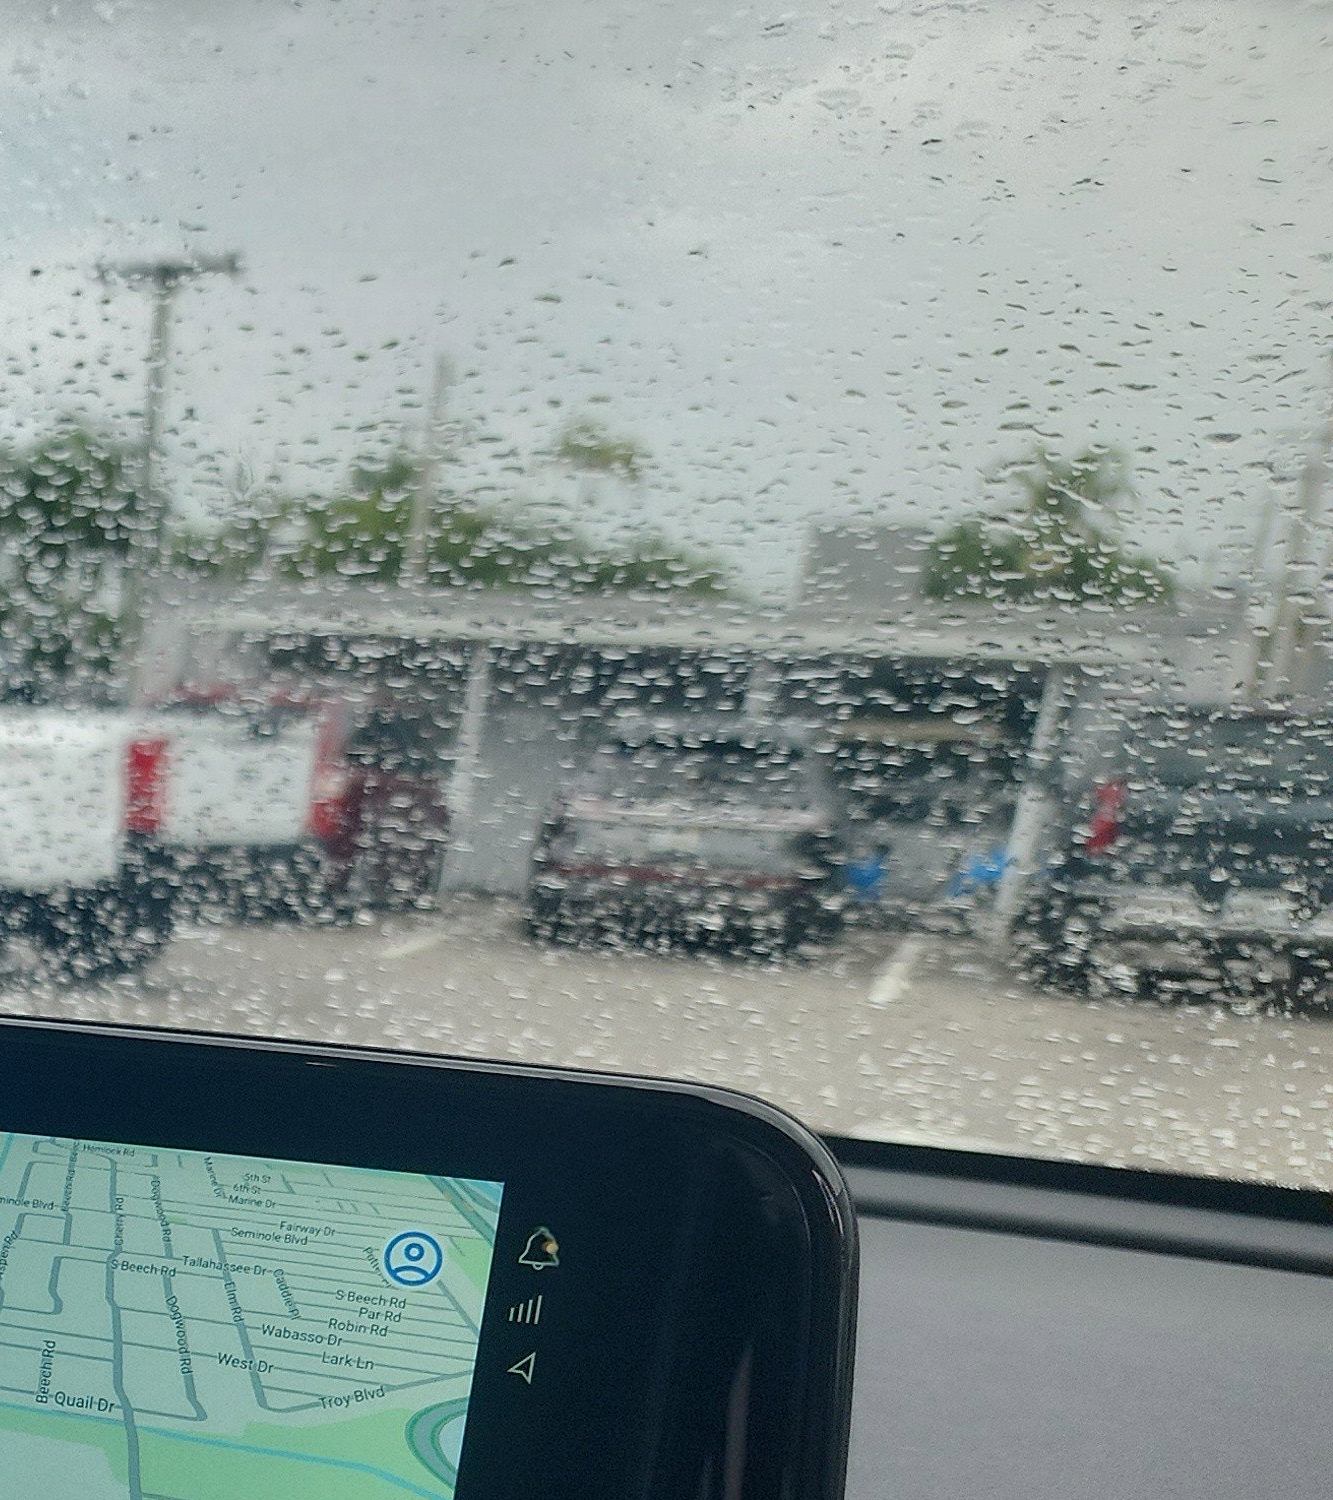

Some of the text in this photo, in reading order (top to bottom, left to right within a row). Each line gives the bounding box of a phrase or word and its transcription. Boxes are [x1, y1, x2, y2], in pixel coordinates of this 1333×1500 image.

[203, 1156, 223, 1188] Marine
[33, 1199, 55, 1210] Blvd
[229, 1193, 276, 1208] Marine Dr
[114, 1197, 125, 1246] Cherry Rd
[279, 1221, 335, 1237] Fairway Dr
[4, 1230, 18, 1247] Rd
[161, 1229, 172, 1242] Rd
[230, 1227, 308, 1246] Seminole Blvd
[110, 1259, 177, 1277] S Beech Rd
[182, 1256, 268, 1276] Tallahassee Dr
[273, 1269, 297, 1310] Caddie
[335, 1289, 407, 1310] S Beech Rd
[223, 1281, 244, 1323] Elm Rd
[358, 1307, 402, 1323] Par Rd
[165, 1295, 193, 1375] Dogwood Rd
[261, 1323, 343, 1347] Wabasso Dr
[328, 1317, 389, 1337] Robin Rd
[216, 1352, 275, 1374] West Dr
[321, 1351, 375, 1370] Lark Ln
[35, 1339, 56, 1405] Beech Rd
[54, 1391, 116, 1414] Quail Dr
[319, 1385, 386, 1410] Troy Blvd
